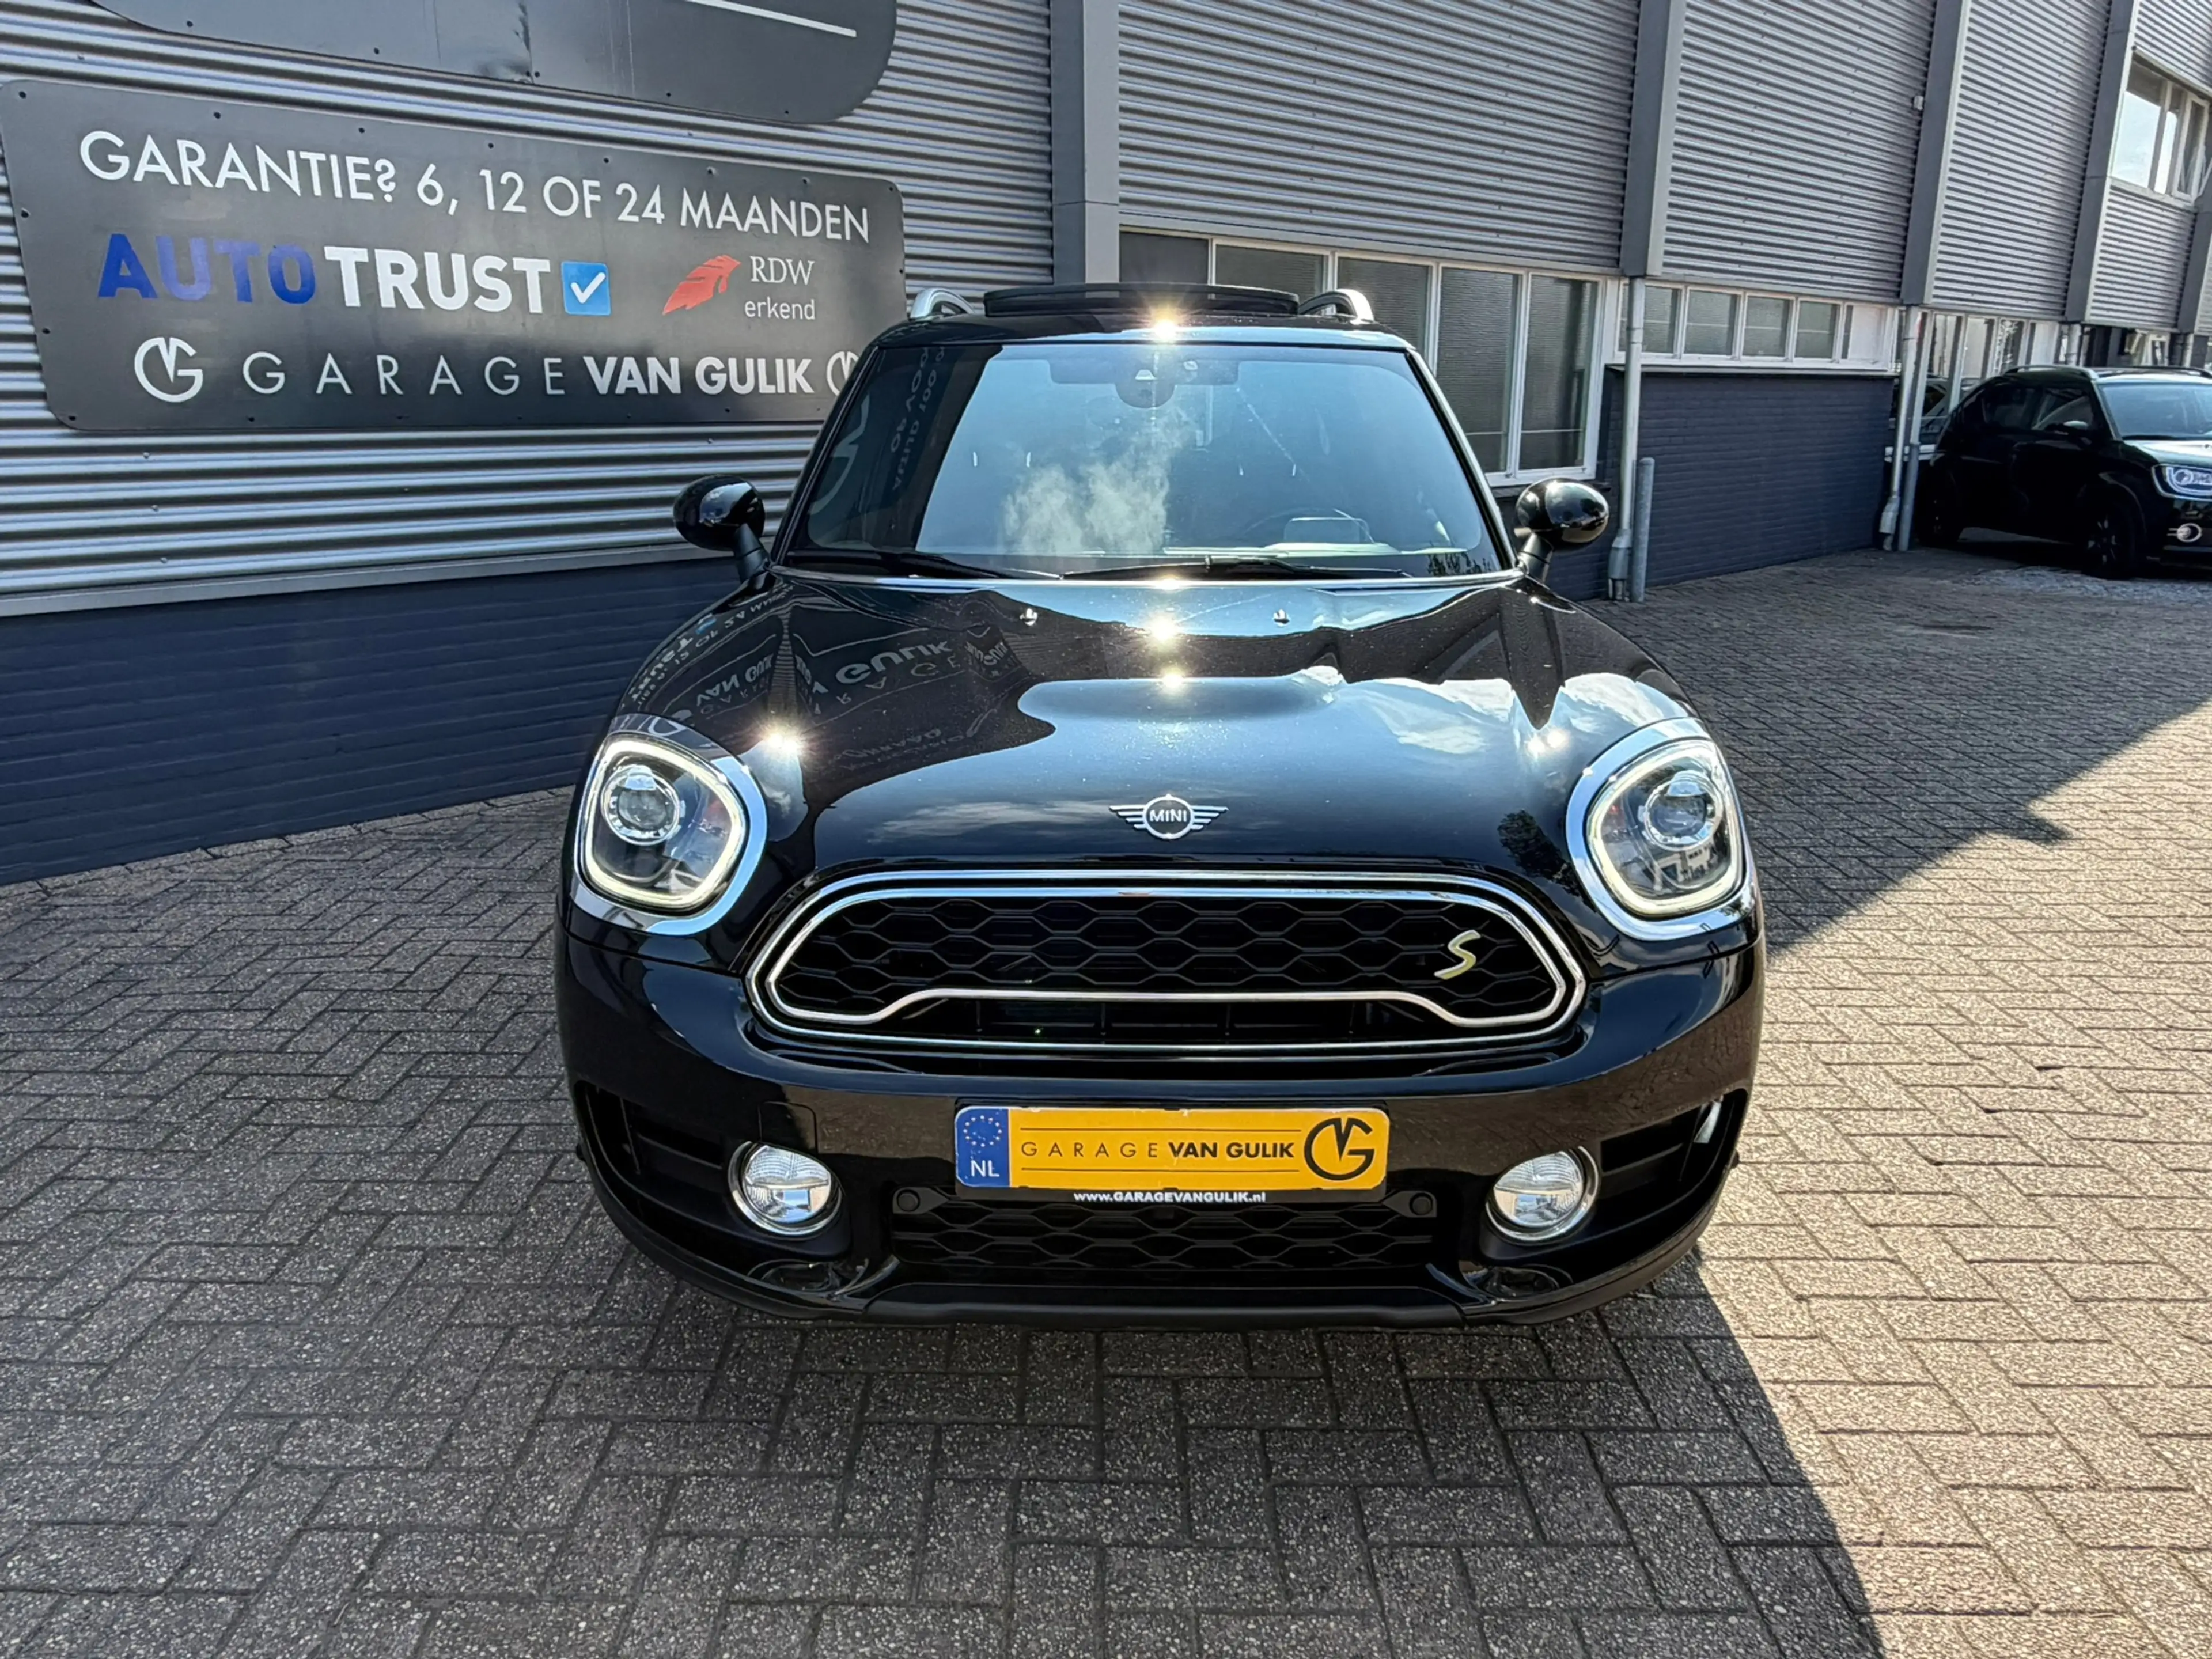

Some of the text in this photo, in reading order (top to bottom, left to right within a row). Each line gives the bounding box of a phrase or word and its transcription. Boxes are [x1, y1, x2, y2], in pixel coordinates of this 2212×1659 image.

[79, 130, 870, 244] GARANTIE? 6, 12 OF 24 MAANDEN
[750, 255, 815, 285] RDW
[744, 297, 816, 320] erkend
[243, 352, 565, 395] GARAGE
[582, 356, 681, 395] VAN
[695, 357, 814, 395] GULIK
[1149, 809, 1188, 823] MINI
[1433, 929, 1482, 980] S
[1021, 1141, 1158, 1159] GARAGE
[1168, 1141, 1217, 1159] VAN
[1226, 1142, 1295, 1159] GULIK
[971, 1160, 1000, 1178] NL
[1073, 1190, 1266, 1204] www.GARAGEVANGULIK.nl
